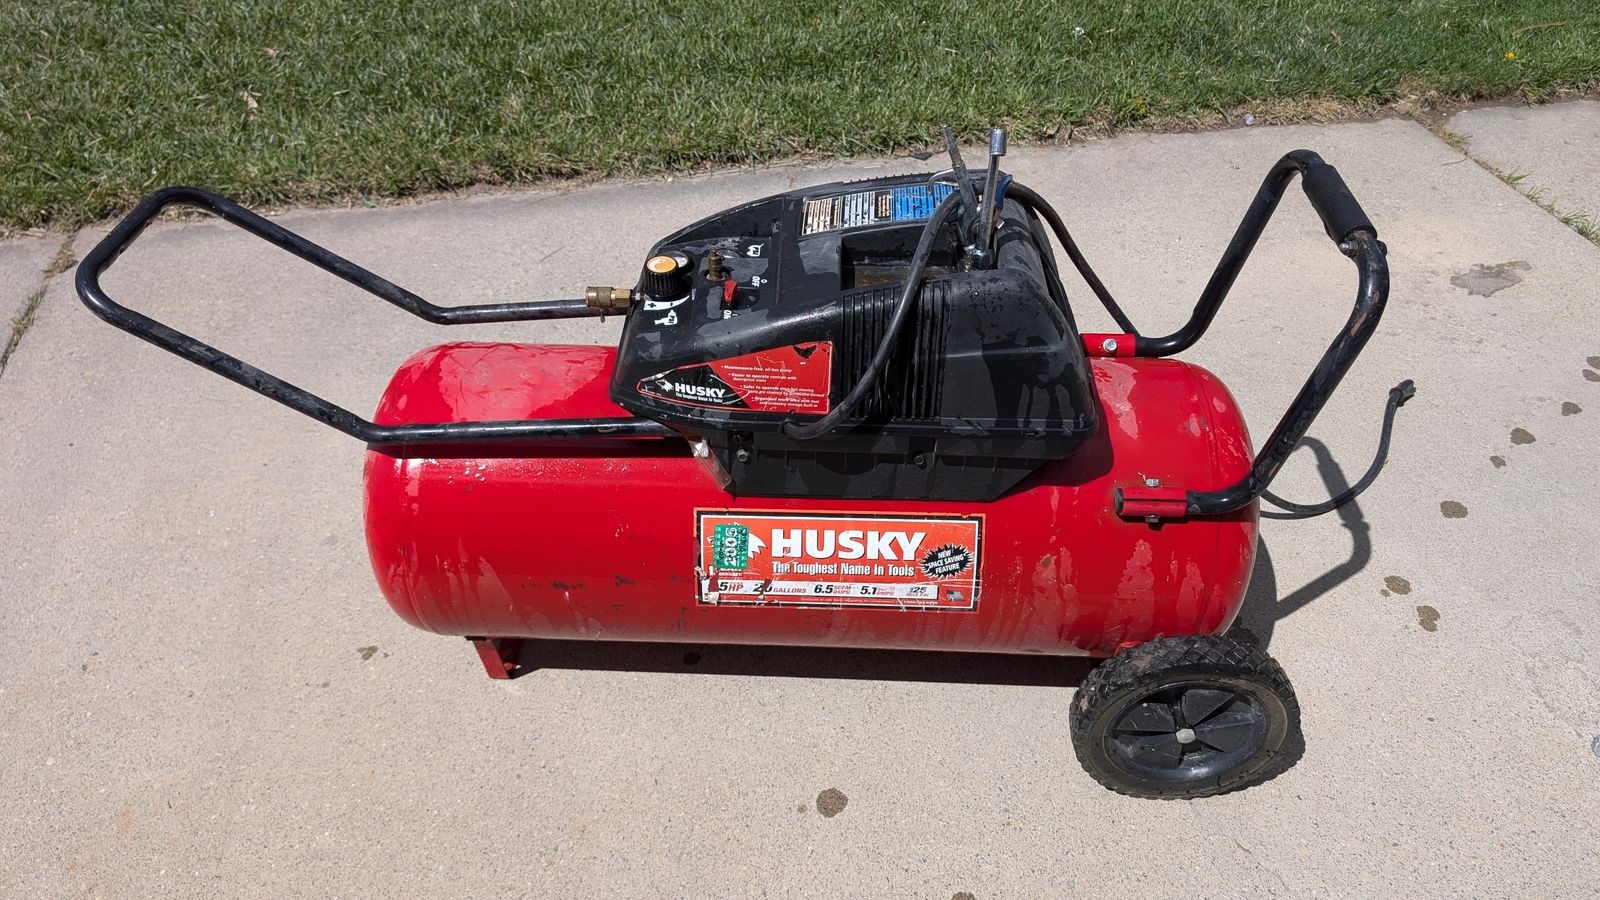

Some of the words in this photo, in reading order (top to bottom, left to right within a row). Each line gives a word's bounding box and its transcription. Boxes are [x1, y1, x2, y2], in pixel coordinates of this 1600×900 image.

[751, 275, 760, 288] OFF
[675, 382, 725, 398] HUSKY
[724, 527, 738, 567] 2005
[771, 528, 927, 560] HUSKY
[772, 561, 791, 574] The
[793, 561, 838, 575] Toughest
[840, 563, 871, 575] Name
[874, 564, 884, 576] In
[888, 564, 914, 576] Tools
[935, 563, 960, 574] FEATURE
[813, 584, 834, 594] 6.5
[860, 586, 877, 595] 5.1
